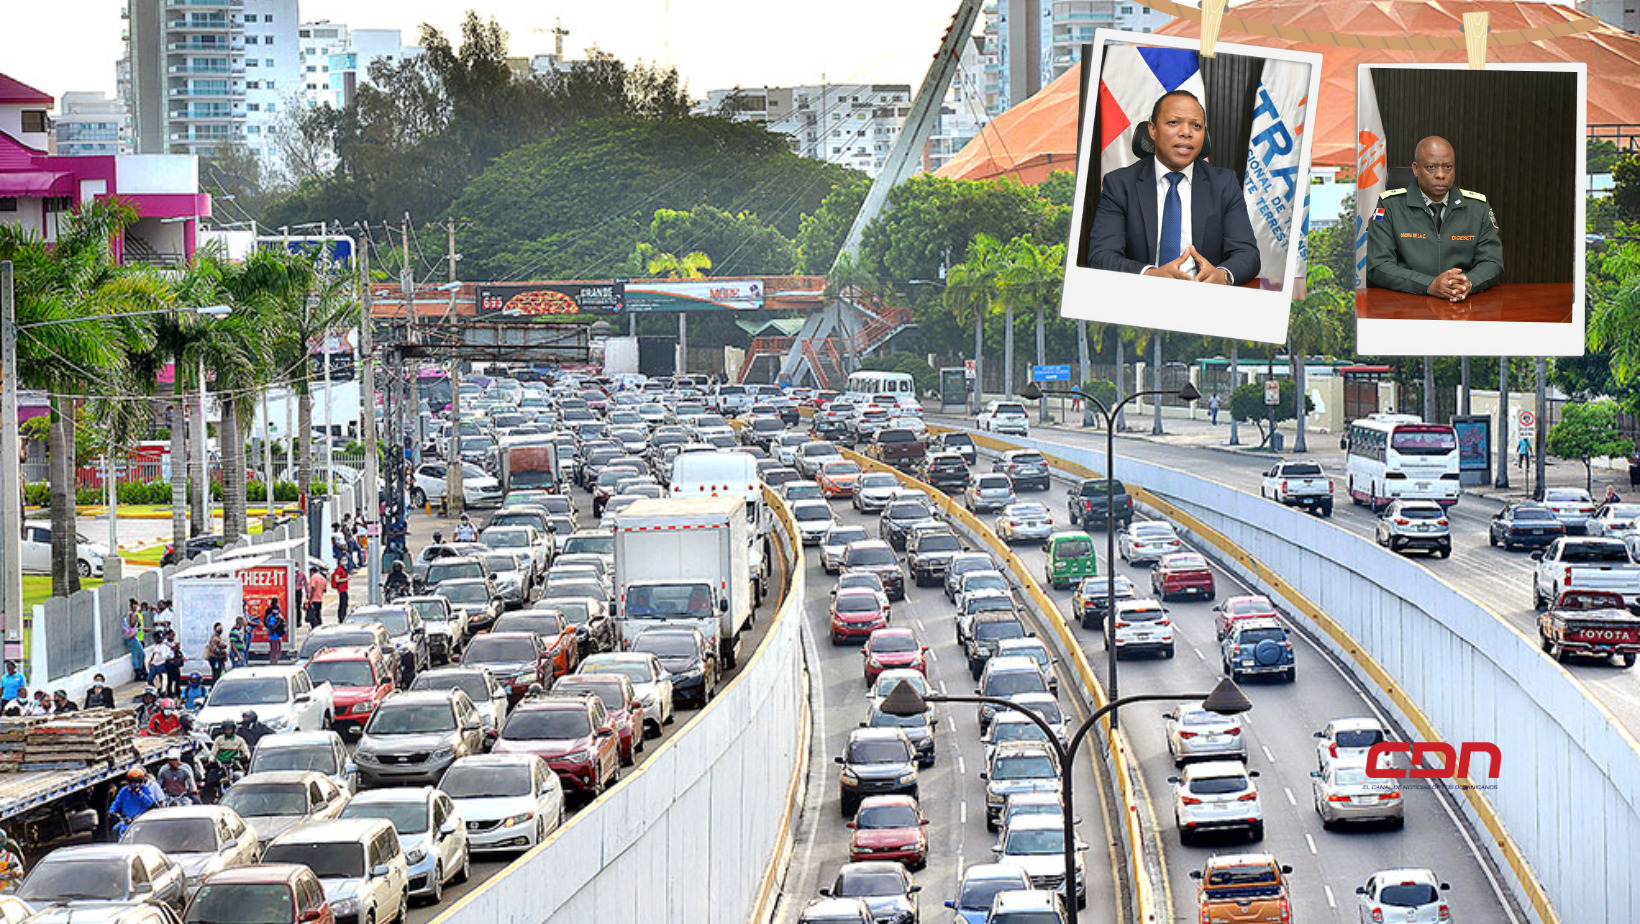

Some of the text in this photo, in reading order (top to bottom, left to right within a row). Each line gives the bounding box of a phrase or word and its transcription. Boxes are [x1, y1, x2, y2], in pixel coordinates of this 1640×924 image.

[1270, 196, 1286, 214] DE
[1256, 196, 1289, 253] TERREST
[1580, 630, 1629, 640] TOYOTA
